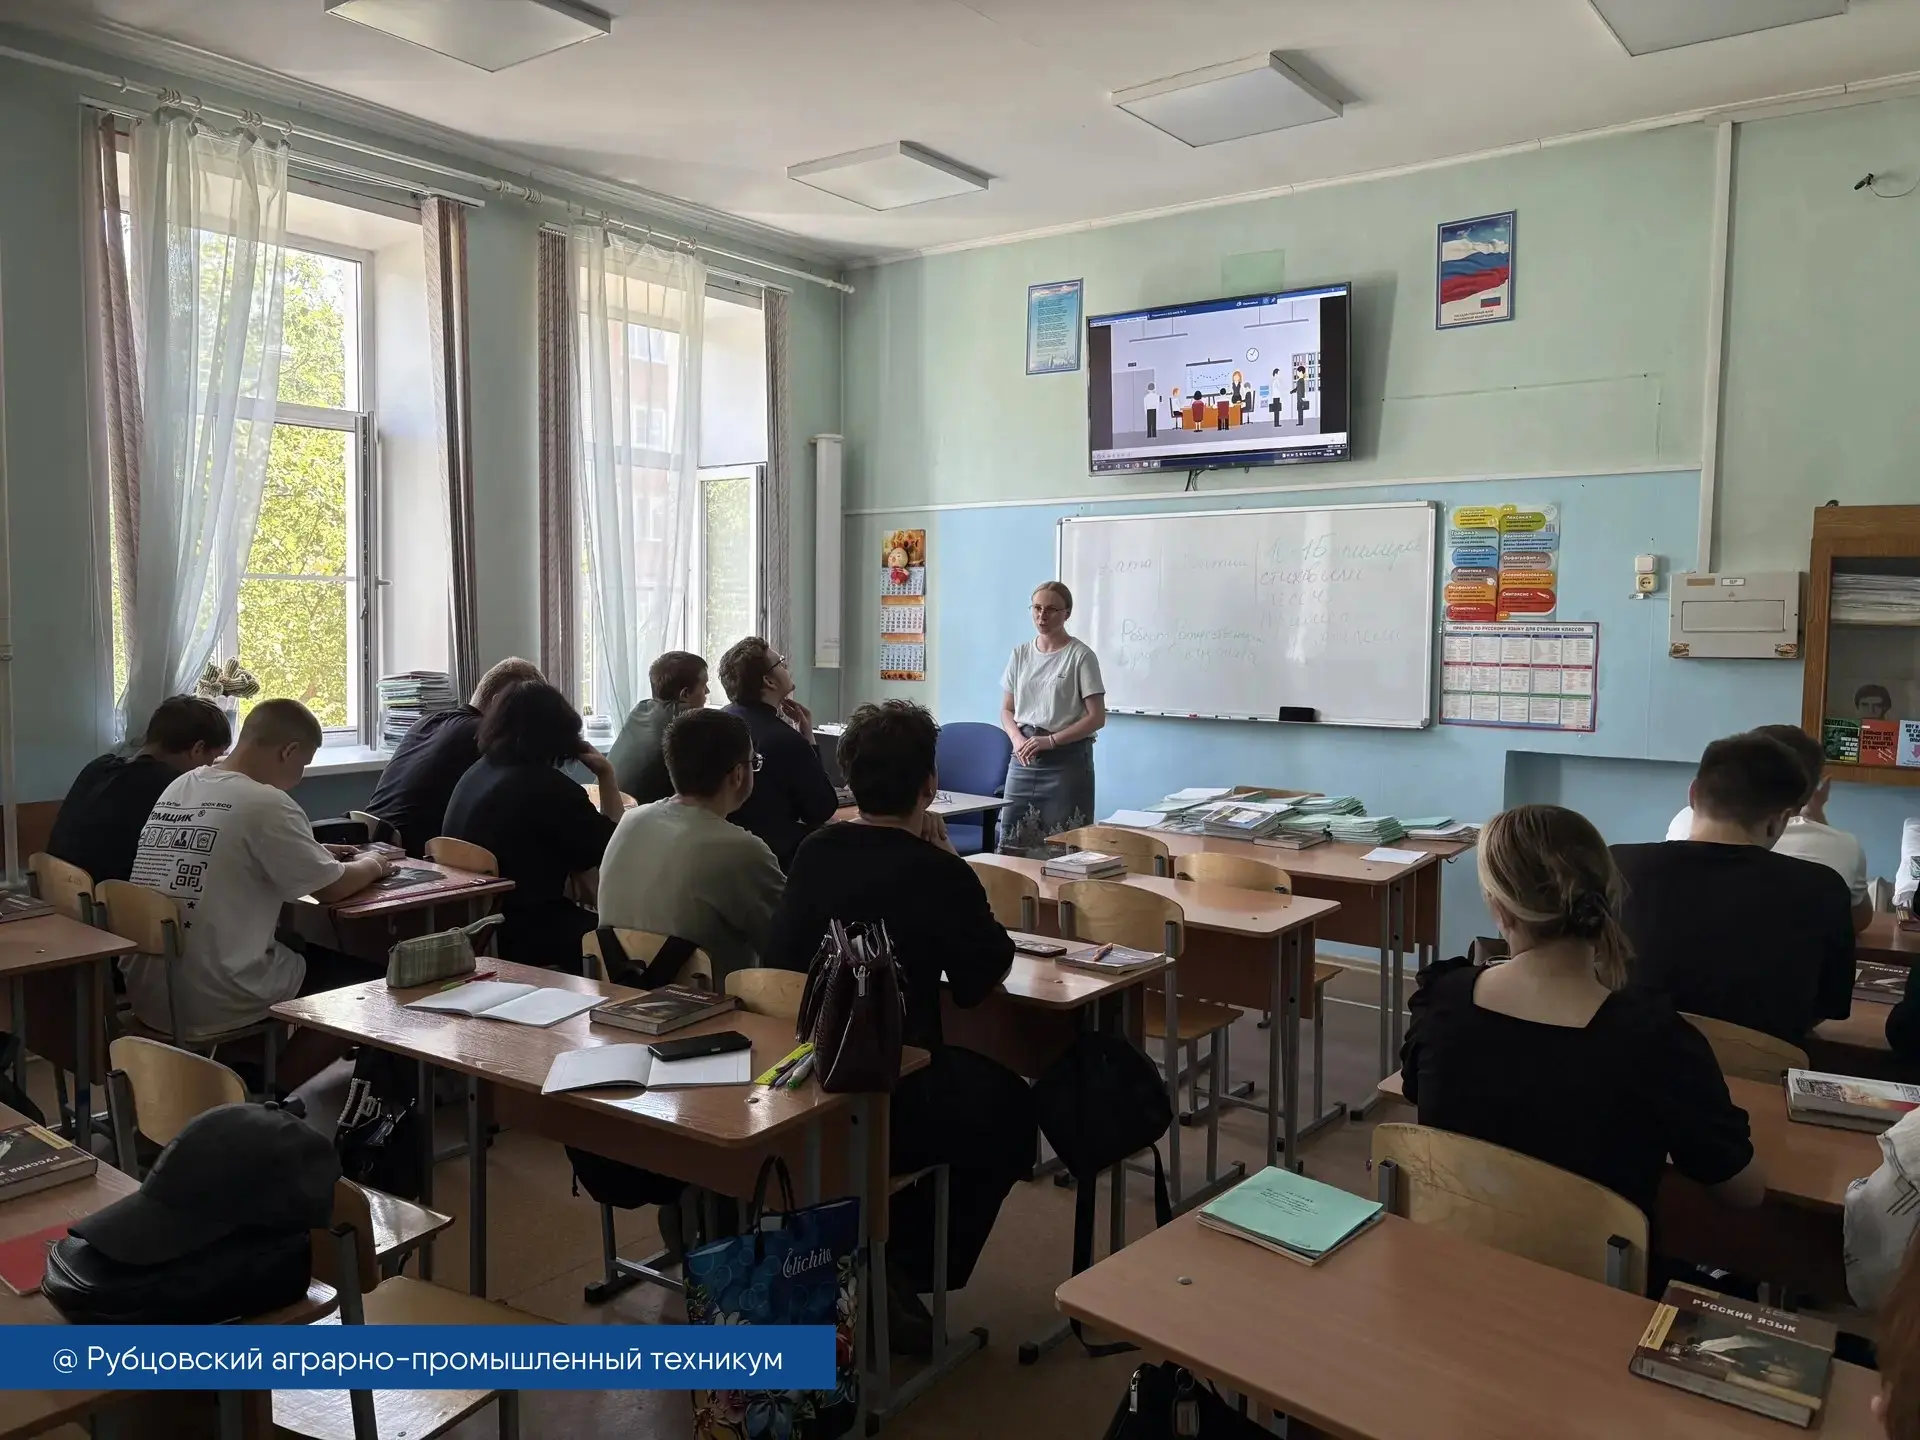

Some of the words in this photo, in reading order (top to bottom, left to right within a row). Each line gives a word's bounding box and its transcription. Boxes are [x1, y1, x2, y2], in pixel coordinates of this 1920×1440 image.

[9, 1155, 61, 1173] РУССКИЙ
[1692, 1298, 1753, 1321] РУССКИЙ
[1757, 1317, 1797, 1333] ЯЗЫК
